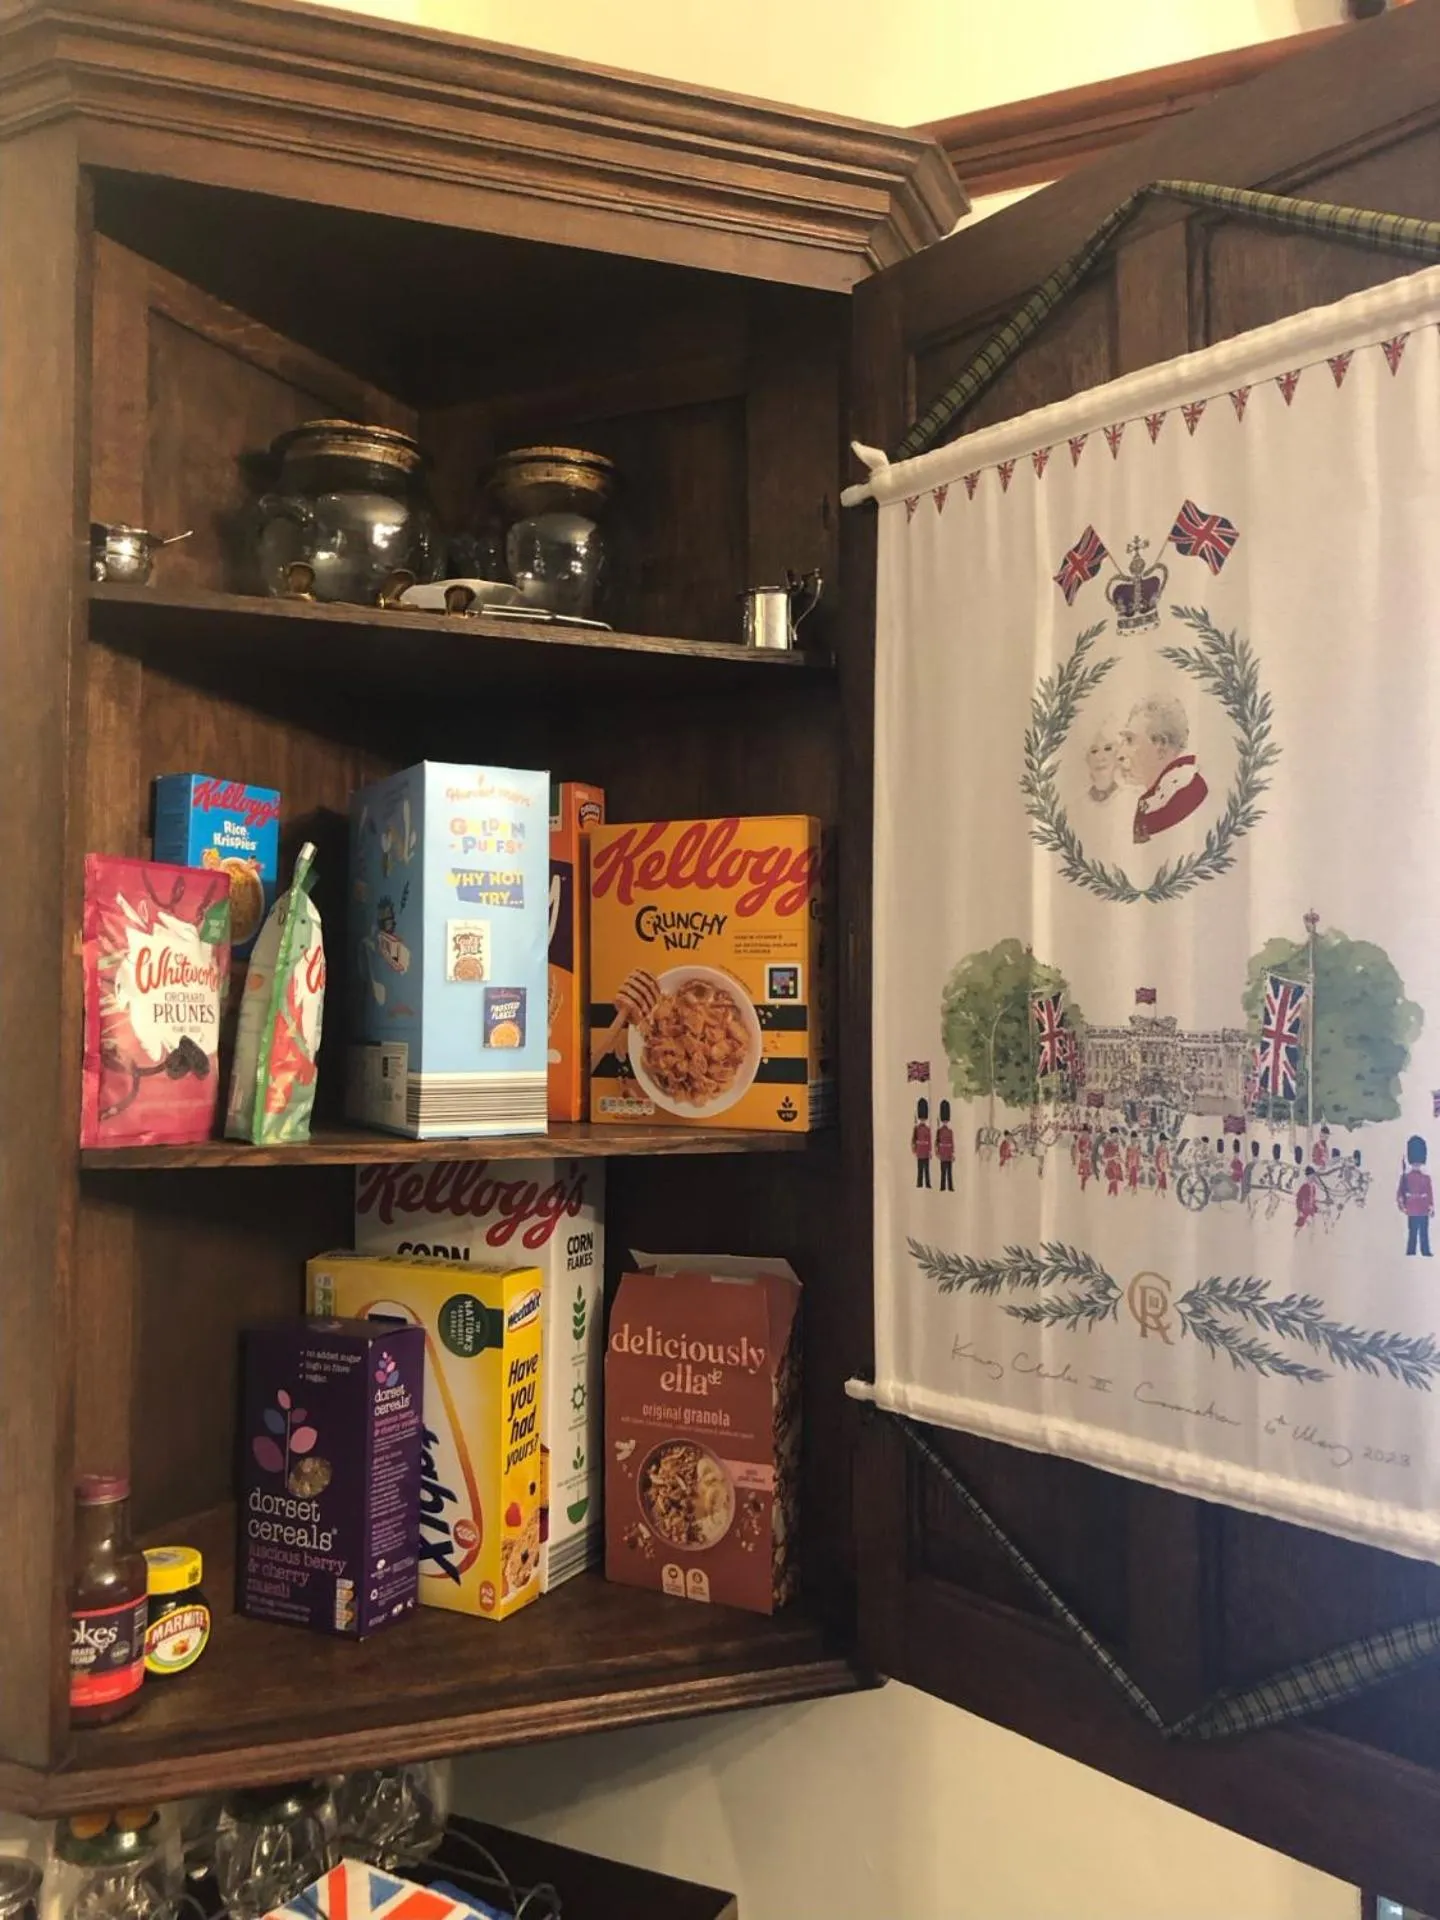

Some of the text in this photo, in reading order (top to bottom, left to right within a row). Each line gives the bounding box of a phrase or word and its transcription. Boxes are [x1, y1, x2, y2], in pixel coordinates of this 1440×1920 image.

[223, 820, 248, 836] Rice
[449, 817, 526, 838] GOLDEN
[213, 832, 258, 851] Krispies
[462, 836, 517, 855] PUFFS
[445, 871, 522, 887] WHY NOT
[592, 817, 822, 918] Kellogg
[665, 931, 704, 951] NUT
[153, 1003, 215, 1024] PRUNES
[356, 1160, 588, 1250] Kellogg's
[567, 1231, 594, 1256] CORN
[567, 1251, 594, 1271] FLAKES
[507, 1292, 542, 1328] Weetabix
[611, 1323, 765, 1375] deliciously
[508, 1355, 538, 1388] Have
[660, 1363, 709, 1397] ella
[375, 1384, 405, 1403] dorset
[375, 1395, 411, 1416] cereals
[508, 1381, 535, 1421] you
[510, 1405, 537, 1445] had
[642, 1403, 681, 1421] original
[683, 1407, 731, 1428] granola
[505, 1433, 539, 1475] yours?
[1363, 1446, 1411, 1468] 2023
[249, 1487, 321, 1522] dorset
[248, 1519, 333, 1551] cereals
[262, 1562, 311, 1588] cherry
[303, 1551, 348, 1576] berry
[72, 1620, 118, 1653] okes
[151, 1609, 205, 1646] MARMITE
